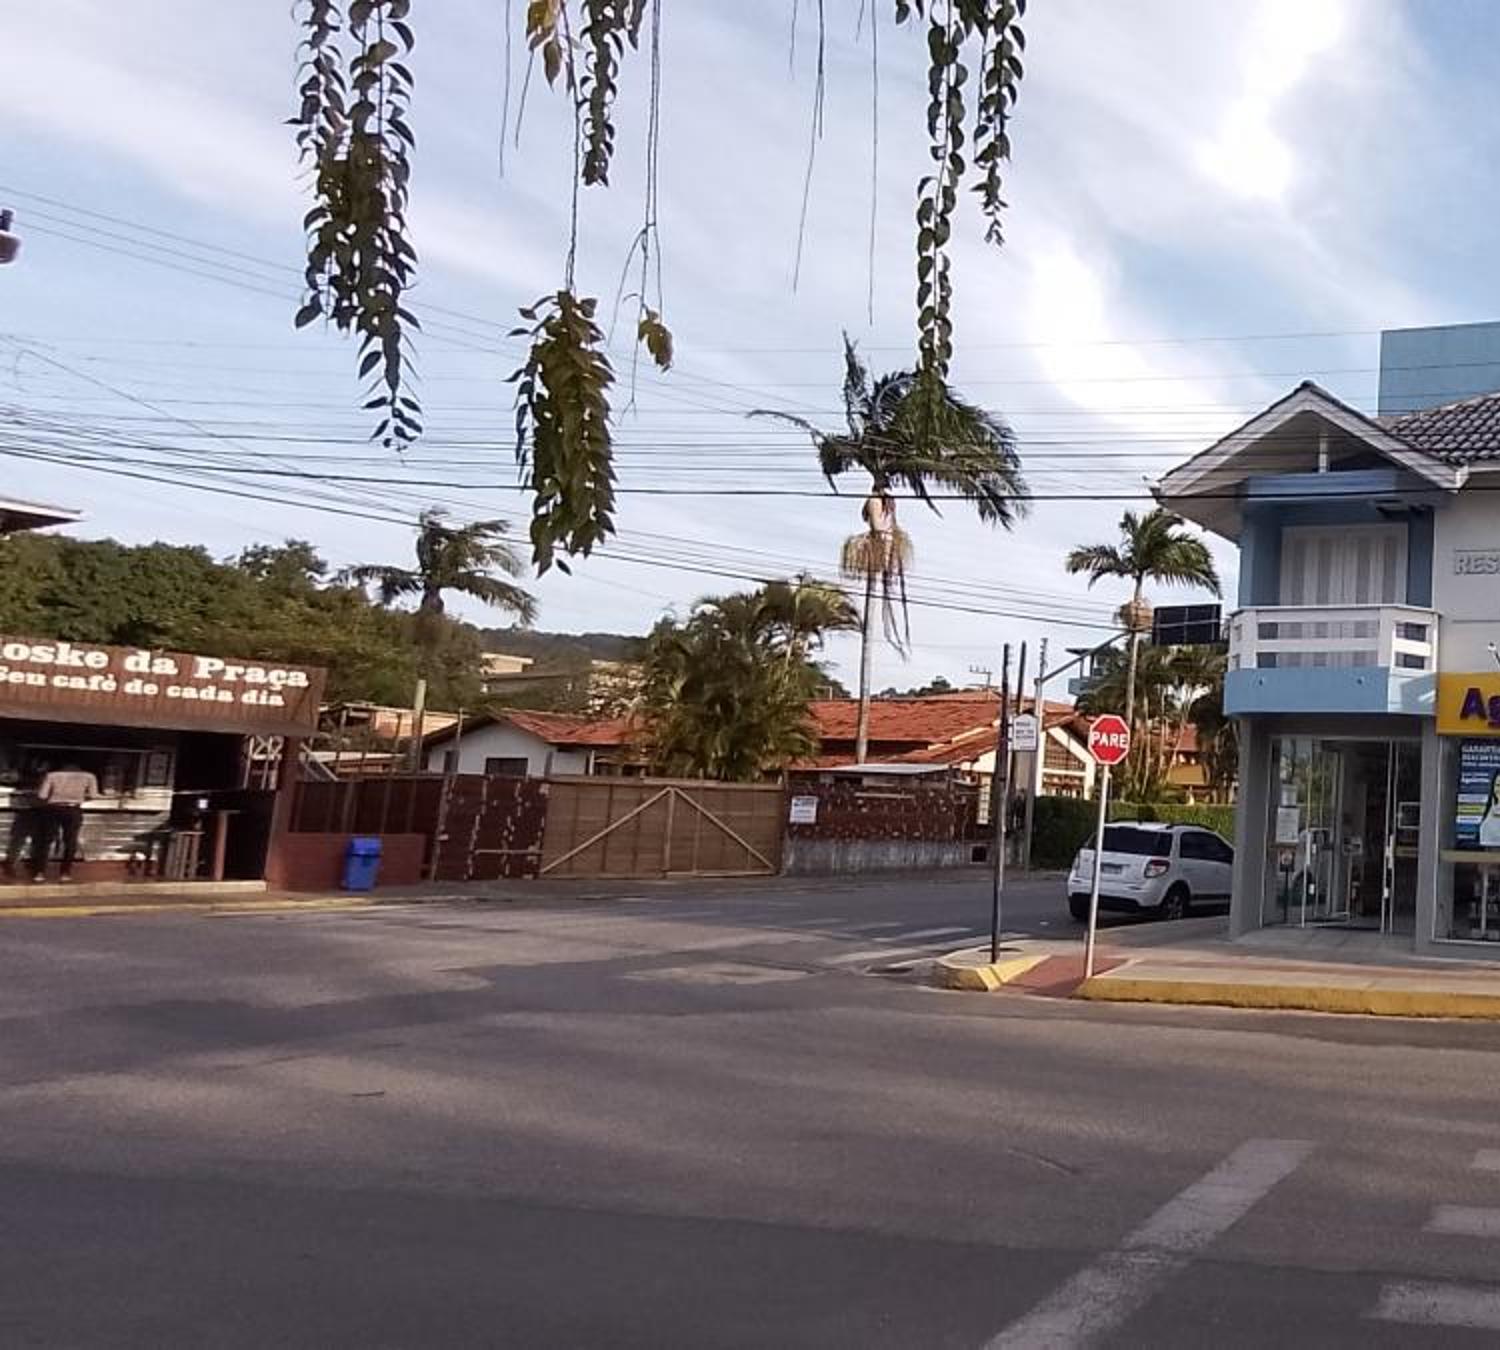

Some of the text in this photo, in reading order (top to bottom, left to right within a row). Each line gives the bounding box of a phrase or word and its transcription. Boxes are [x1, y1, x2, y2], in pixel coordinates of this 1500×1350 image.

[0, 641, 309, 691] oske da Praça
[124, 678, 158, 695] de
[166, 685, 235, 702] cada
[241, 689, 285, 706] dia
[1091, 731, 1129, 748] PARE
